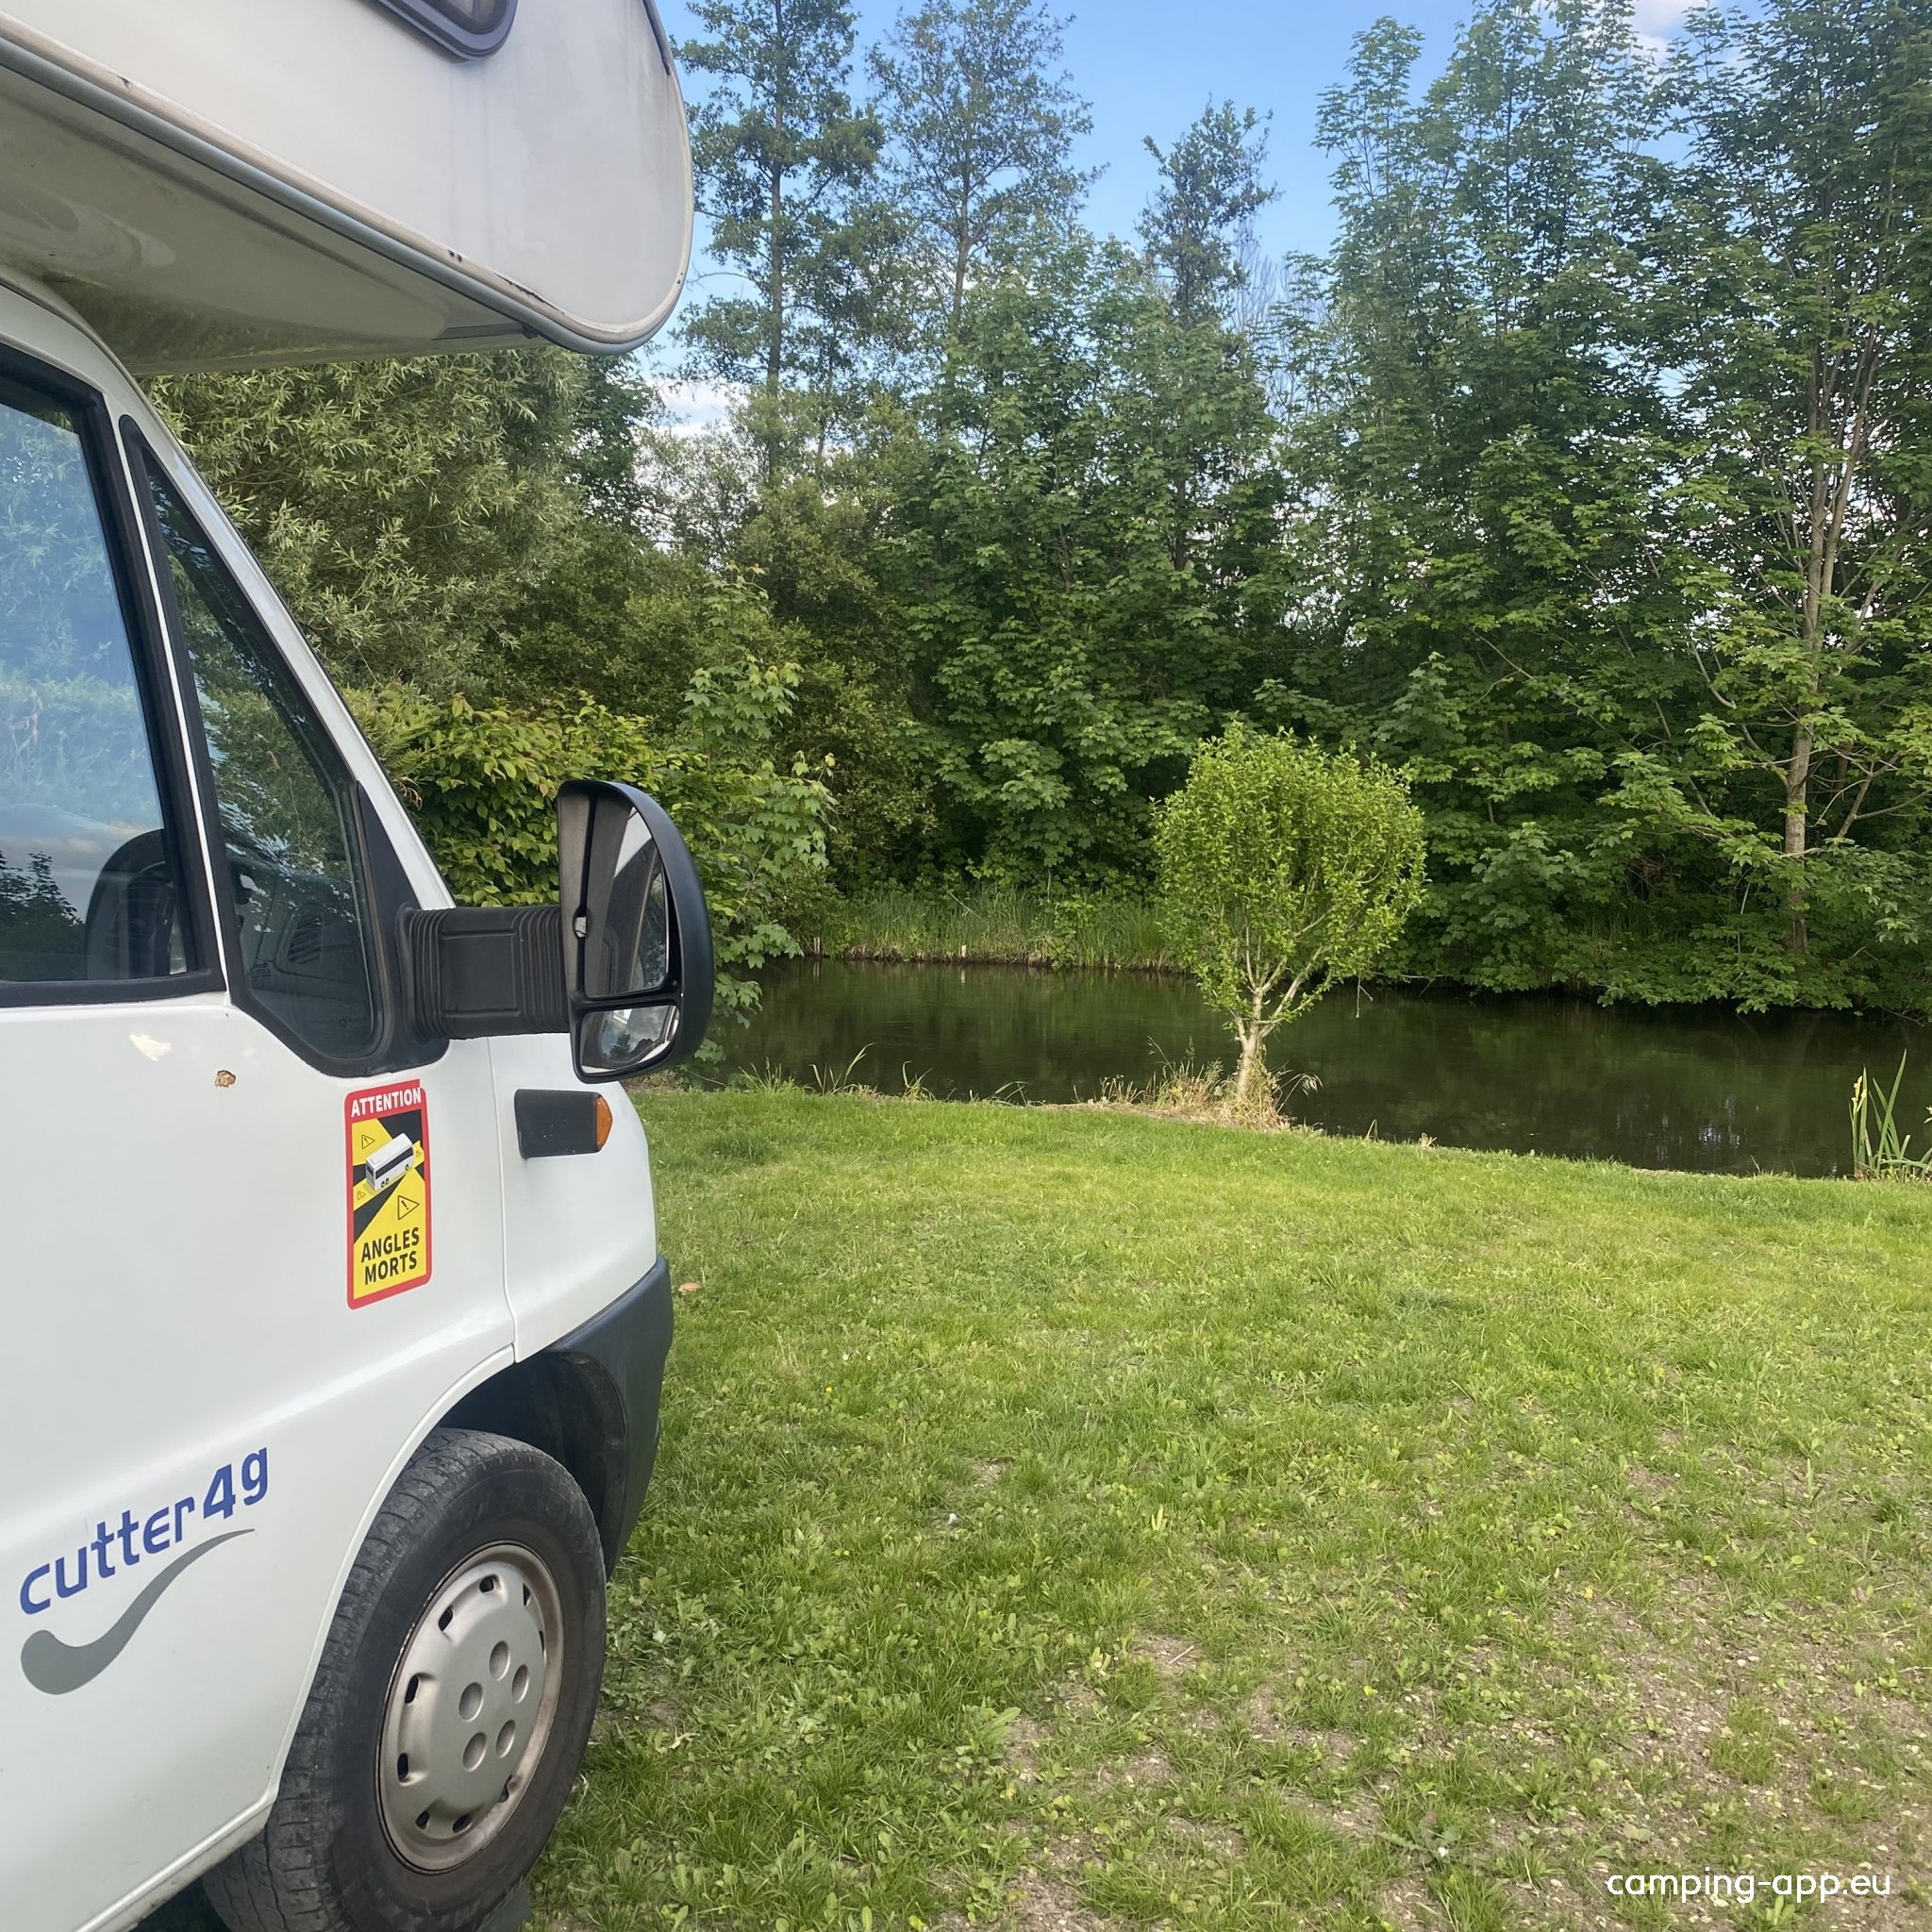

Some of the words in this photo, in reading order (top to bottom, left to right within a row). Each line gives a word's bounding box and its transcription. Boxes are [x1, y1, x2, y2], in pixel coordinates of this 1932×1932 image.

[351, 1087, 422, 1117] ATTENTION
[361, 1226, 420, 1263] ANGLES
[364, 1250, 418, 1286] MORTS
